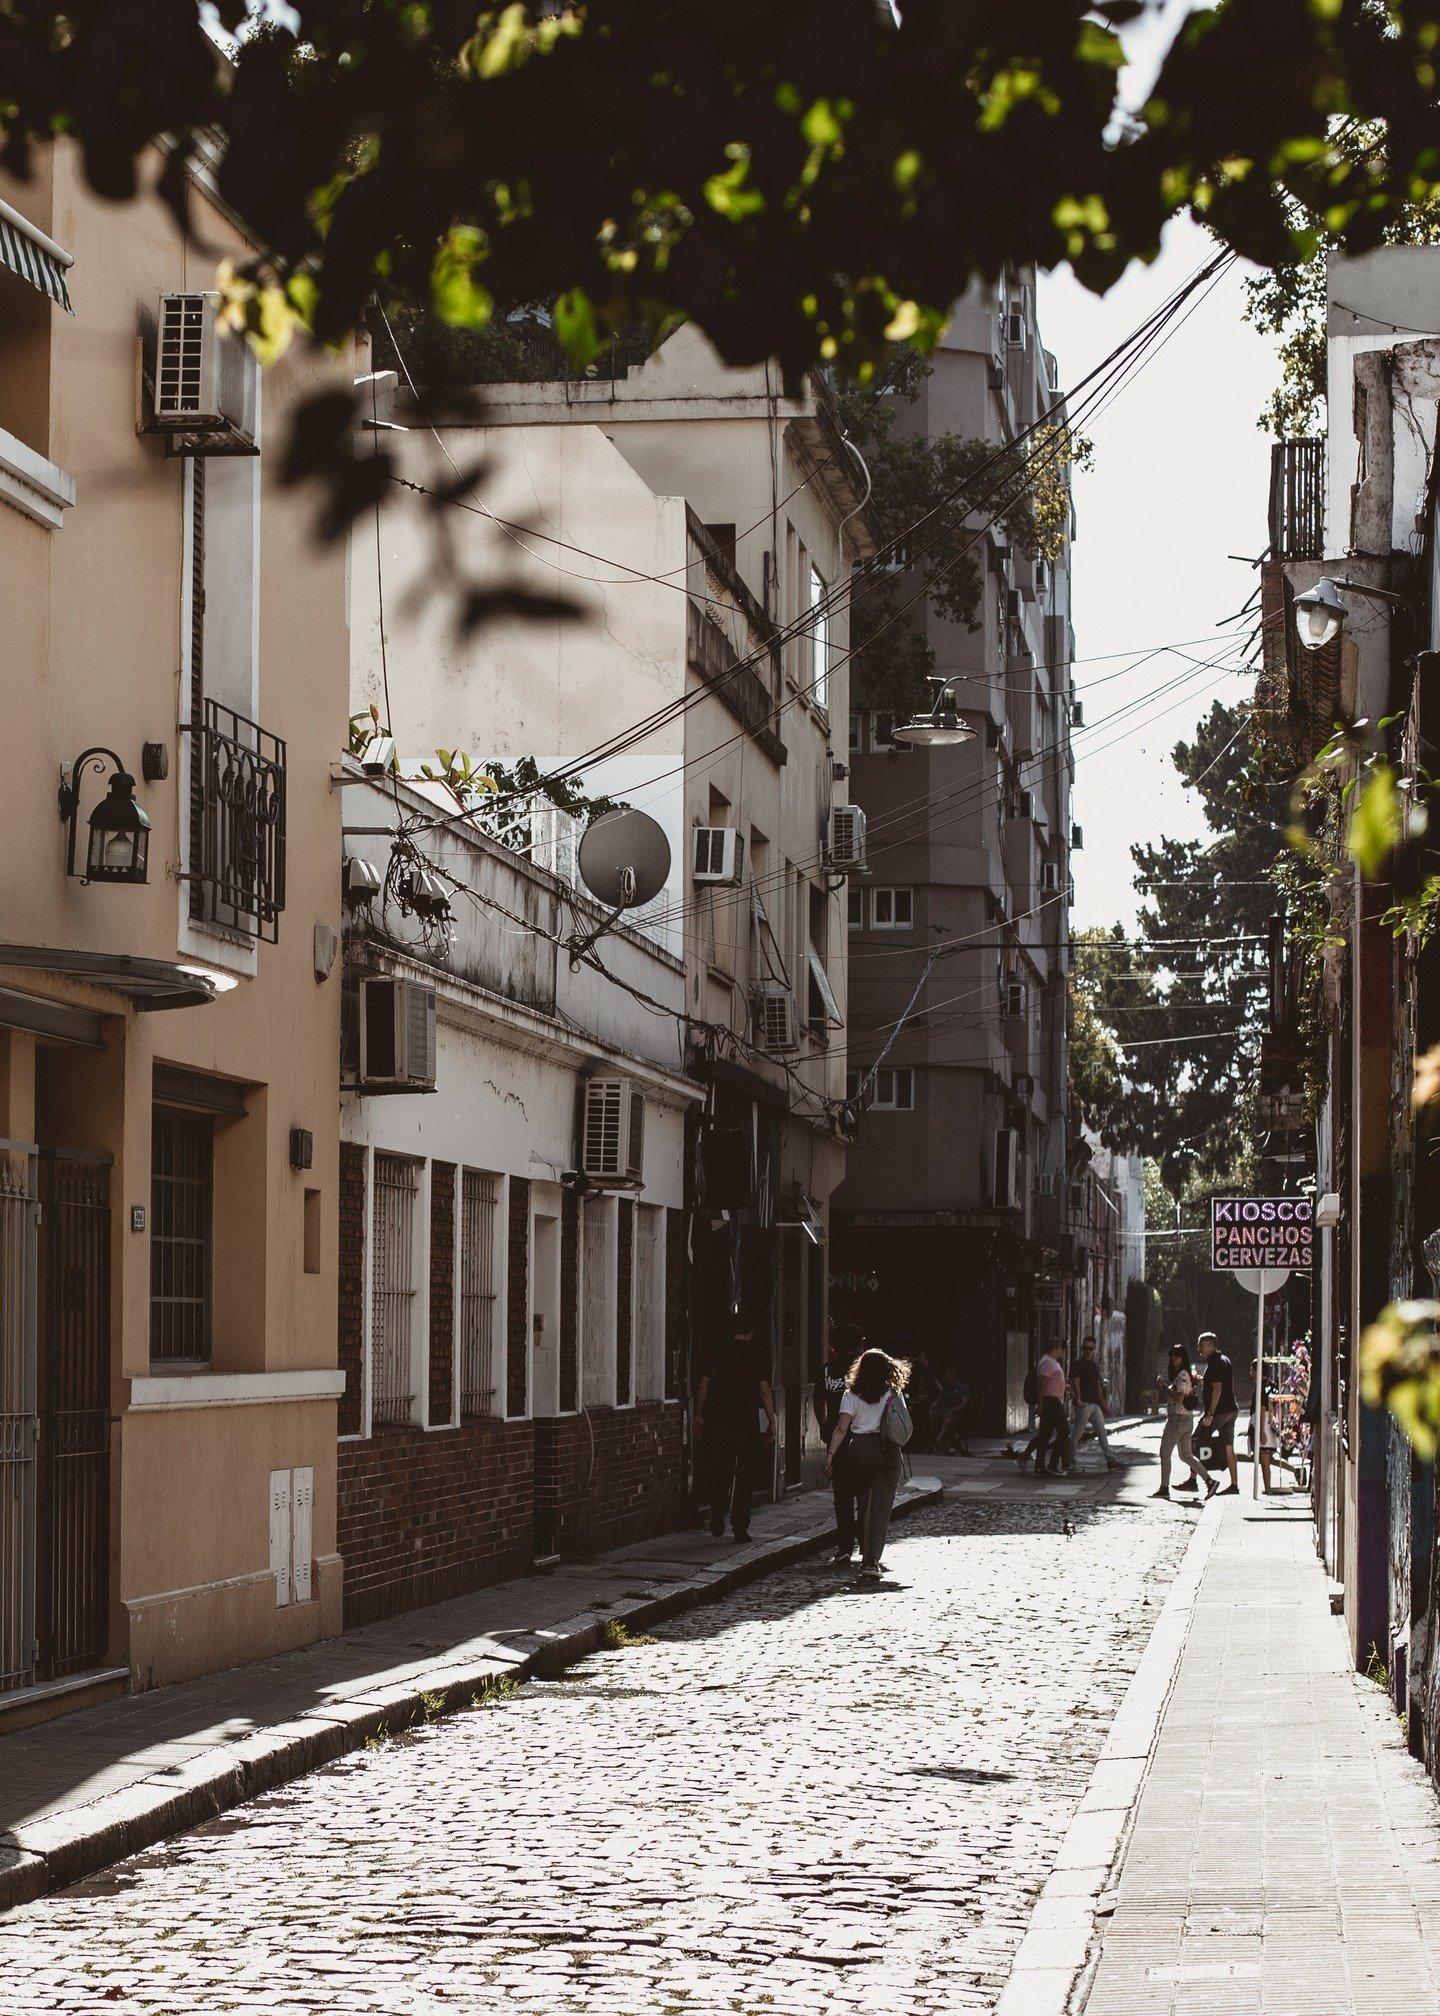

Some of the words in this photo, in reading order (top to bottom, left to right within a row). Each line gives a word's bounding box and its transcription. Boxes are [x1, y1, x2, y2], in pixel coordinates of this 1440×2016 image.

[1215, 1202, 1312, 1221] KIOSCO
[1215, 1226, 1312, 1244] PANCHOS
[1215, 1247, 1312, 1266] CERVEZAS
[1200, 1446, 1213, 1461] D
